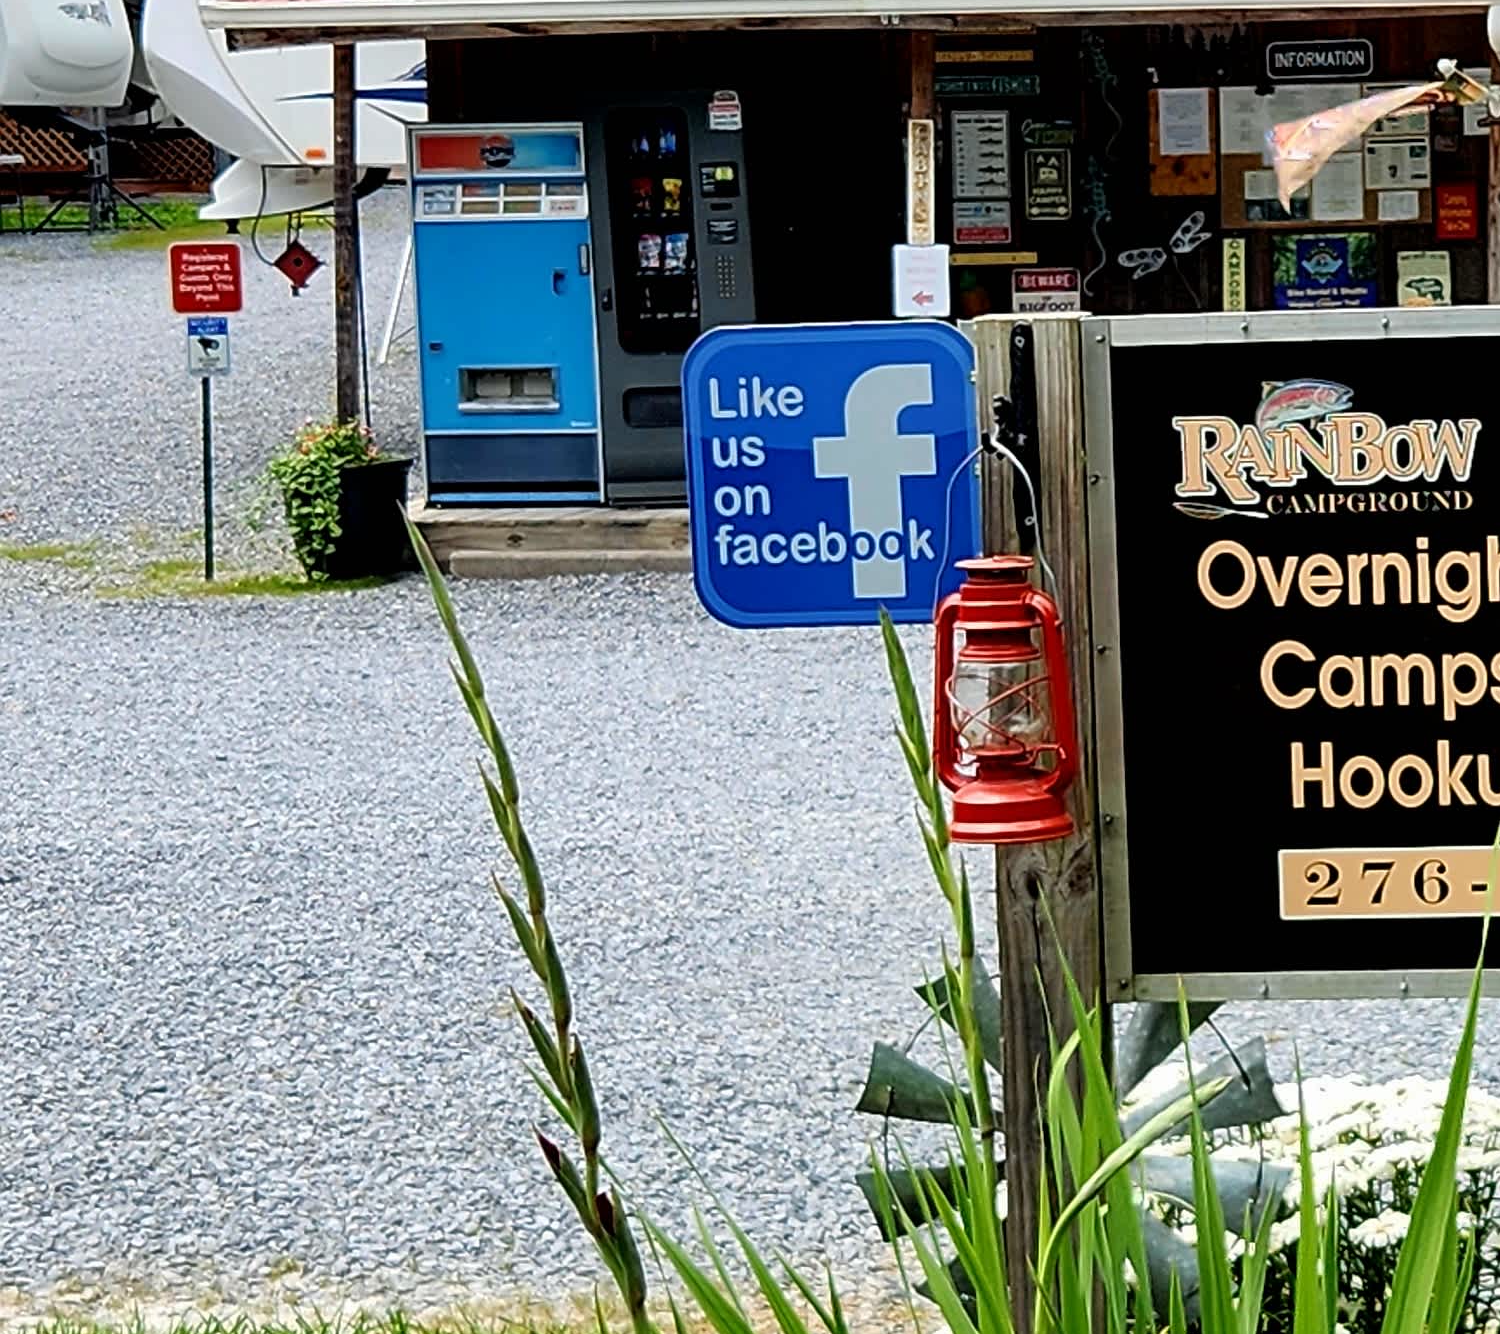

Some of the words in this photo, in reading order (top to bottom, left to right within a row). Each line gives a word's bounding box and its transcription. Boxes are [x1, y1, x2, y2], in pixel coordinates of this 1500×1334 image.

[1274, 50, 1365, 68] INFORMATION
[1022, 273, 1070, 287] BEWARE
[1019, 302, 1075, 312] BIGFOOT
[709, 376, 804, 418] Like
[712, 435, 766, 468] us
[714, 483, 771, 516] on
[1266, 489, 1474, 515] CAMPGROUND
[714, 519, 935, 565] facebook
